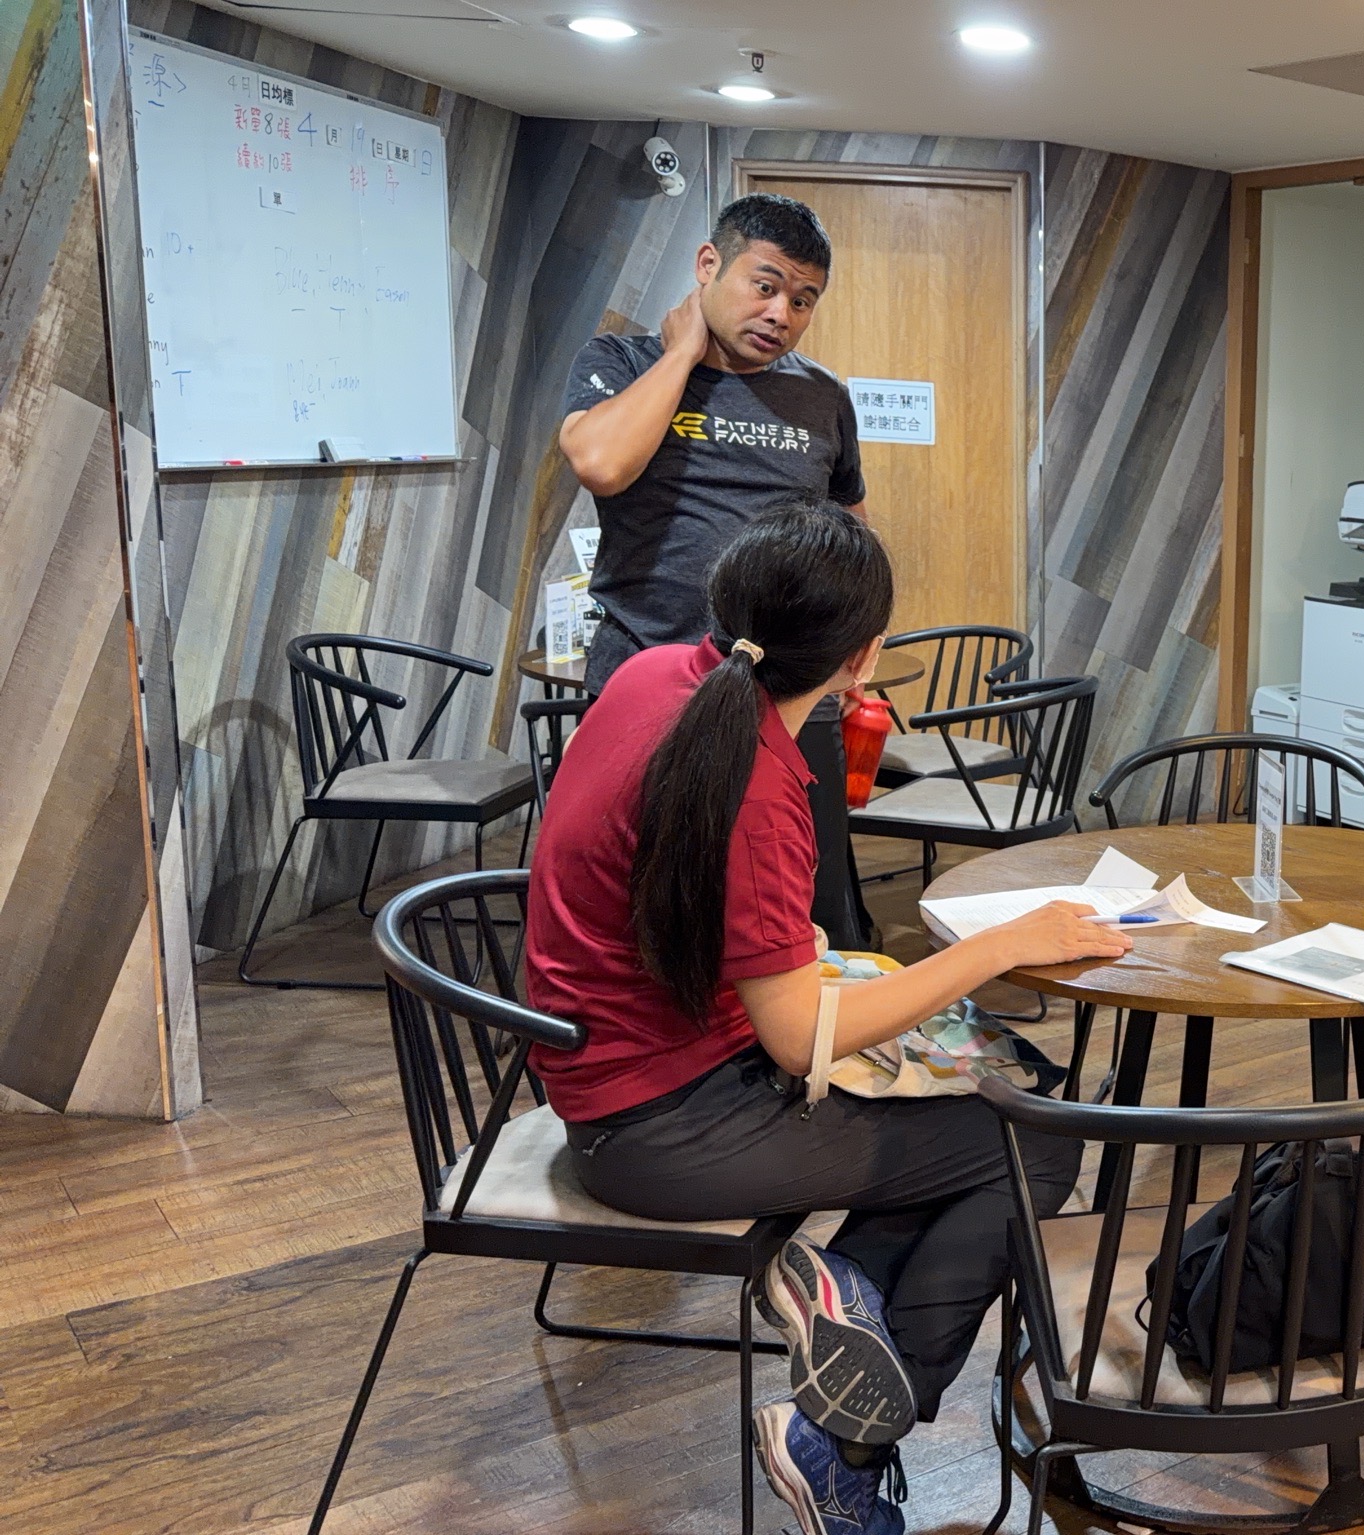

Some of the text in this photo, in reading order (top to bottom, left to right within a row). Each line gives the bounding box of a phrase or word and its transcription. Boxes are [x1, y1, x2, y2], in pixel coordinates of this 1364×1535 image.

[856, 392, 928, 411] 請隨手關門
[714, 416, 810, 441] FITNESS
[863, 414, 922, 432] 謝謝配合
[715, 429, 810, 454] FACTORY
